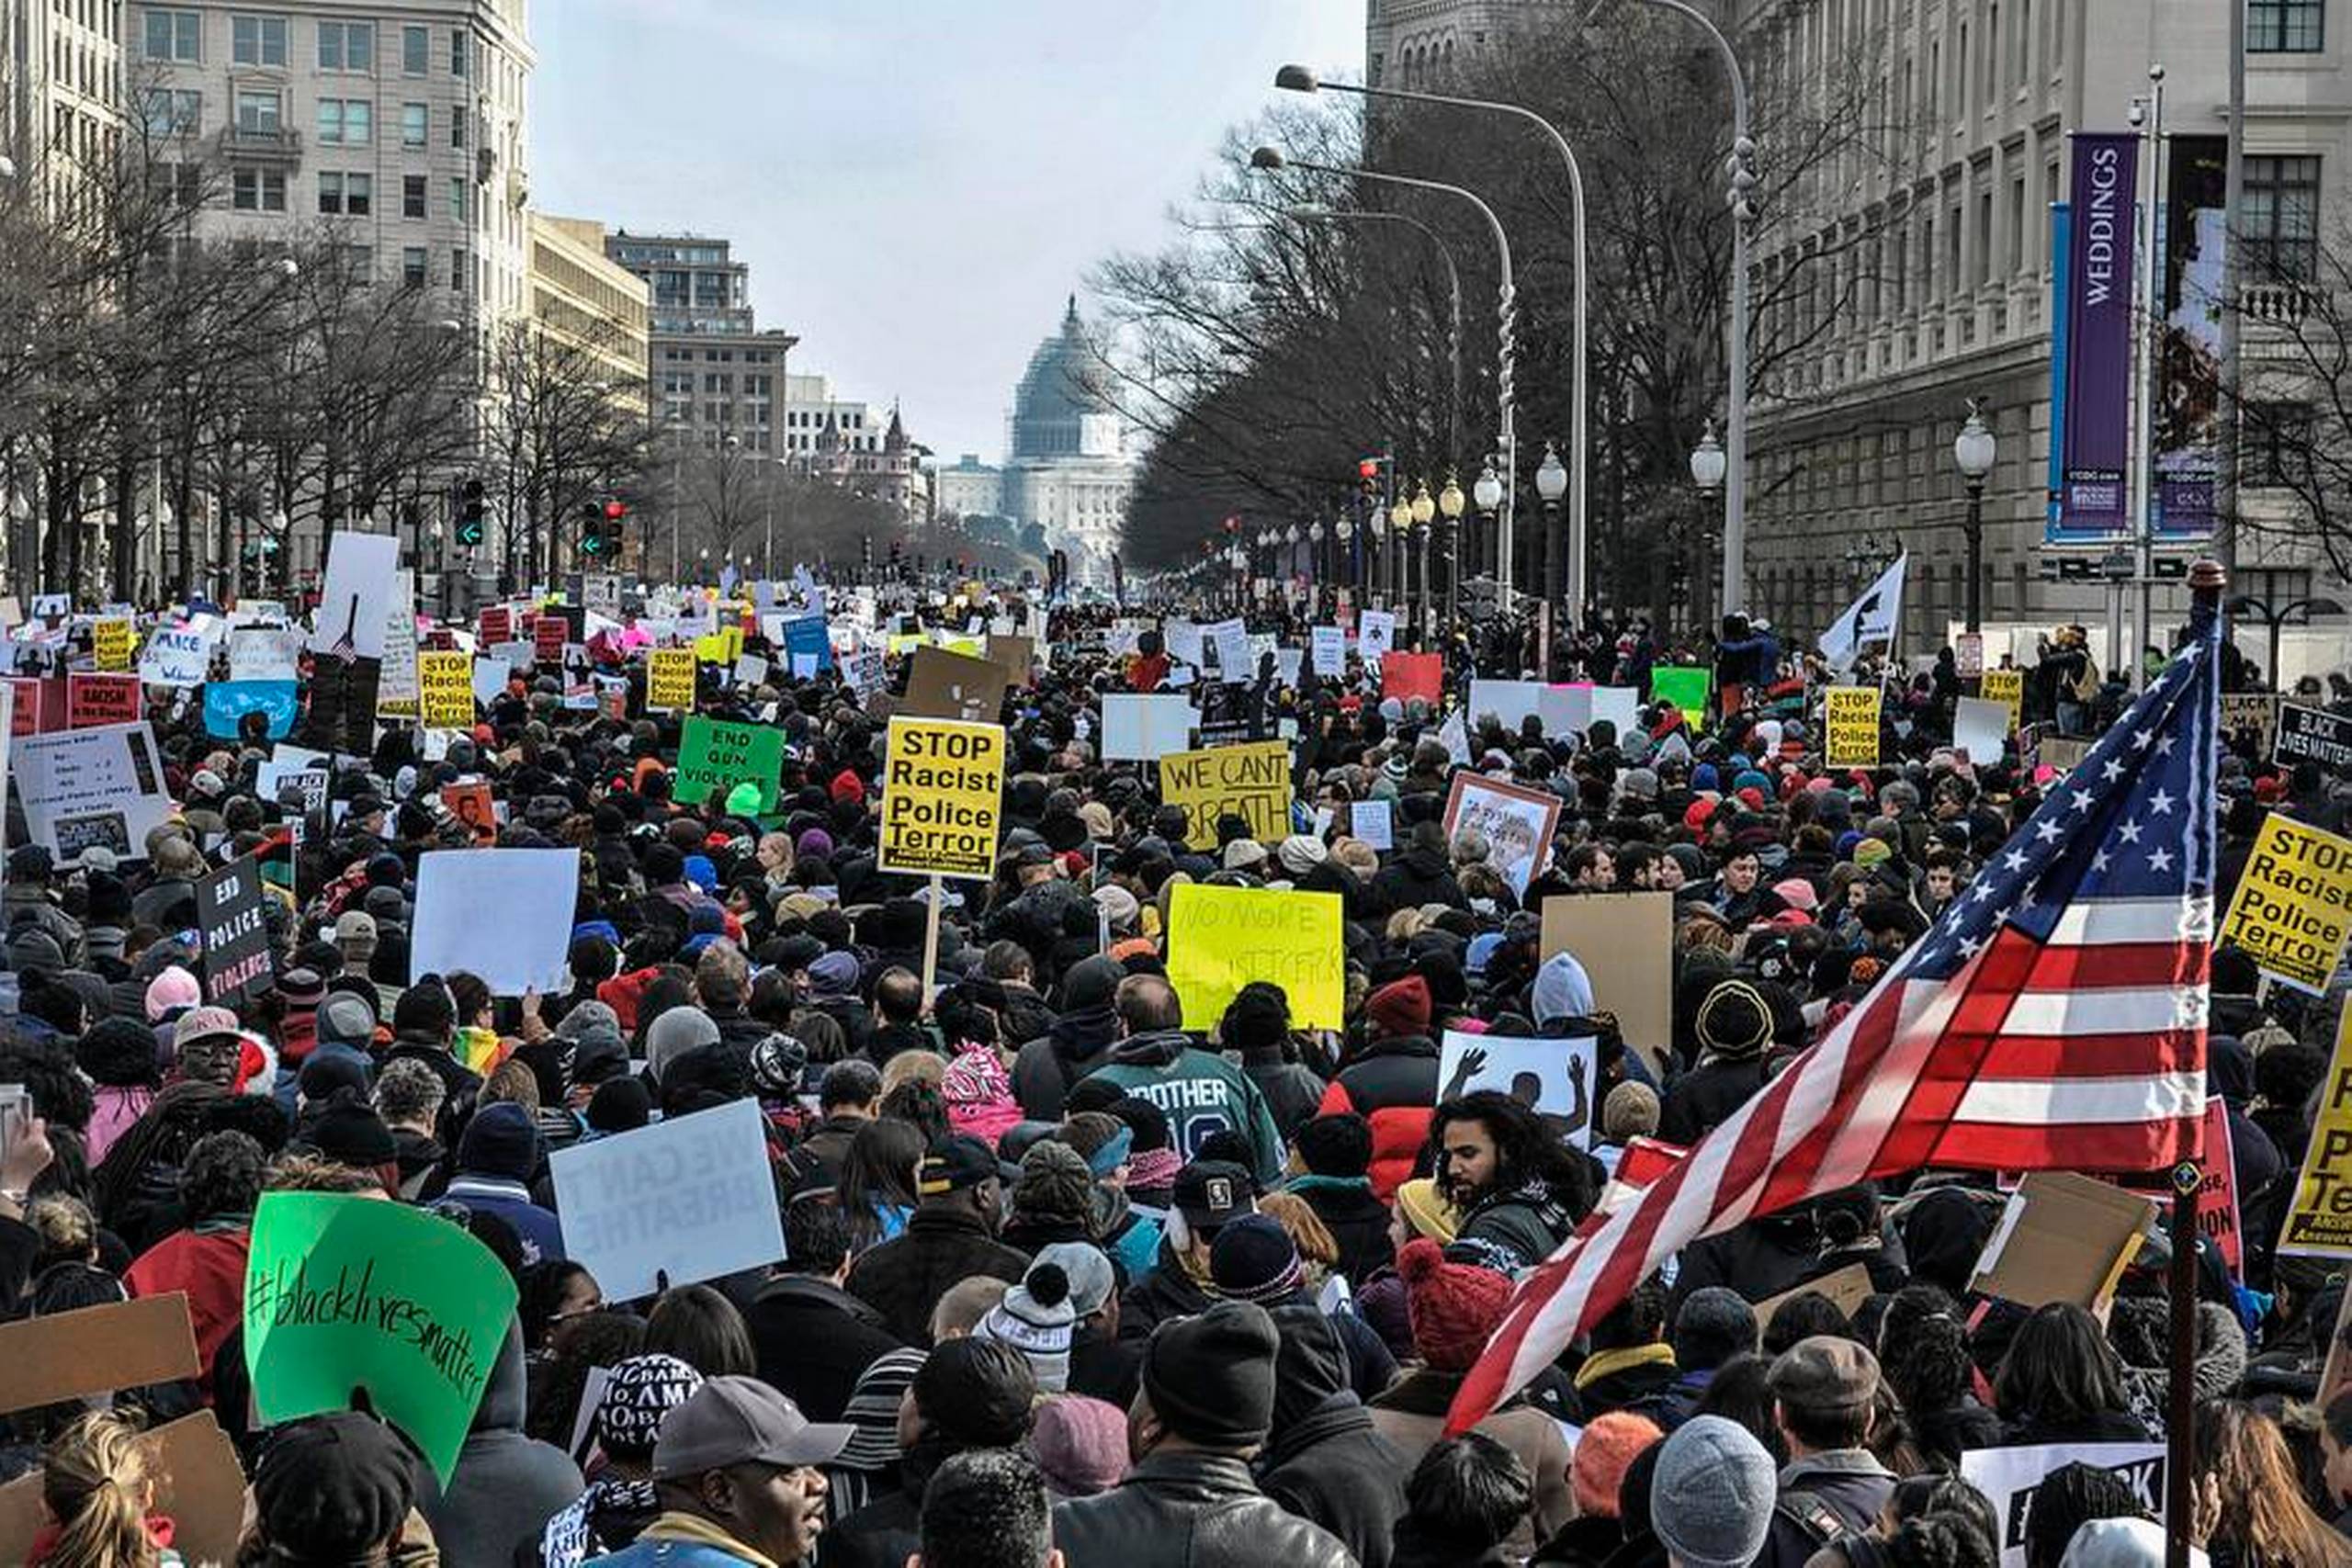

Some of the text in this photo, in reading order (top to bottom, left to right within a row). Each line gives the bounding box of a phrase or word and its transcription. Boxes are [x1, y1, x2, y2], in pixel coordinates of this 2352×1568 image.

[2086, 149, 2118, 306] WEDDINGS
[652, 667, 694, 678] Racist
[655, 653, 691, 665] STOP
[1832, 693, 1873, 708] STOP
[1828, 709, 1877, 725] Racist
[712, 728, 752, 747] END
[902, 730, 992, 761] STOP
[1830, 727, 1877, 745] Police
[1830, 740, 1876, 757] Terror
[707, 749, 747, 766] GUN
[891, 760, 999, 794] Racist
[1167, 757, 1213, 791] WE
[891, 795, 993, 829] Police
[888, 822, 992, 854] Terror
[2269, 829, 2352, 874] STOP
[208, 906, 262, 953] POLICE
[1182, 897, 1221, 930] NO
[2239, 887, 2342, 944] Police
[2233, 909, 2335, 967] Terror
[247, 1256, 485, 1404] #blacklivesmatter
